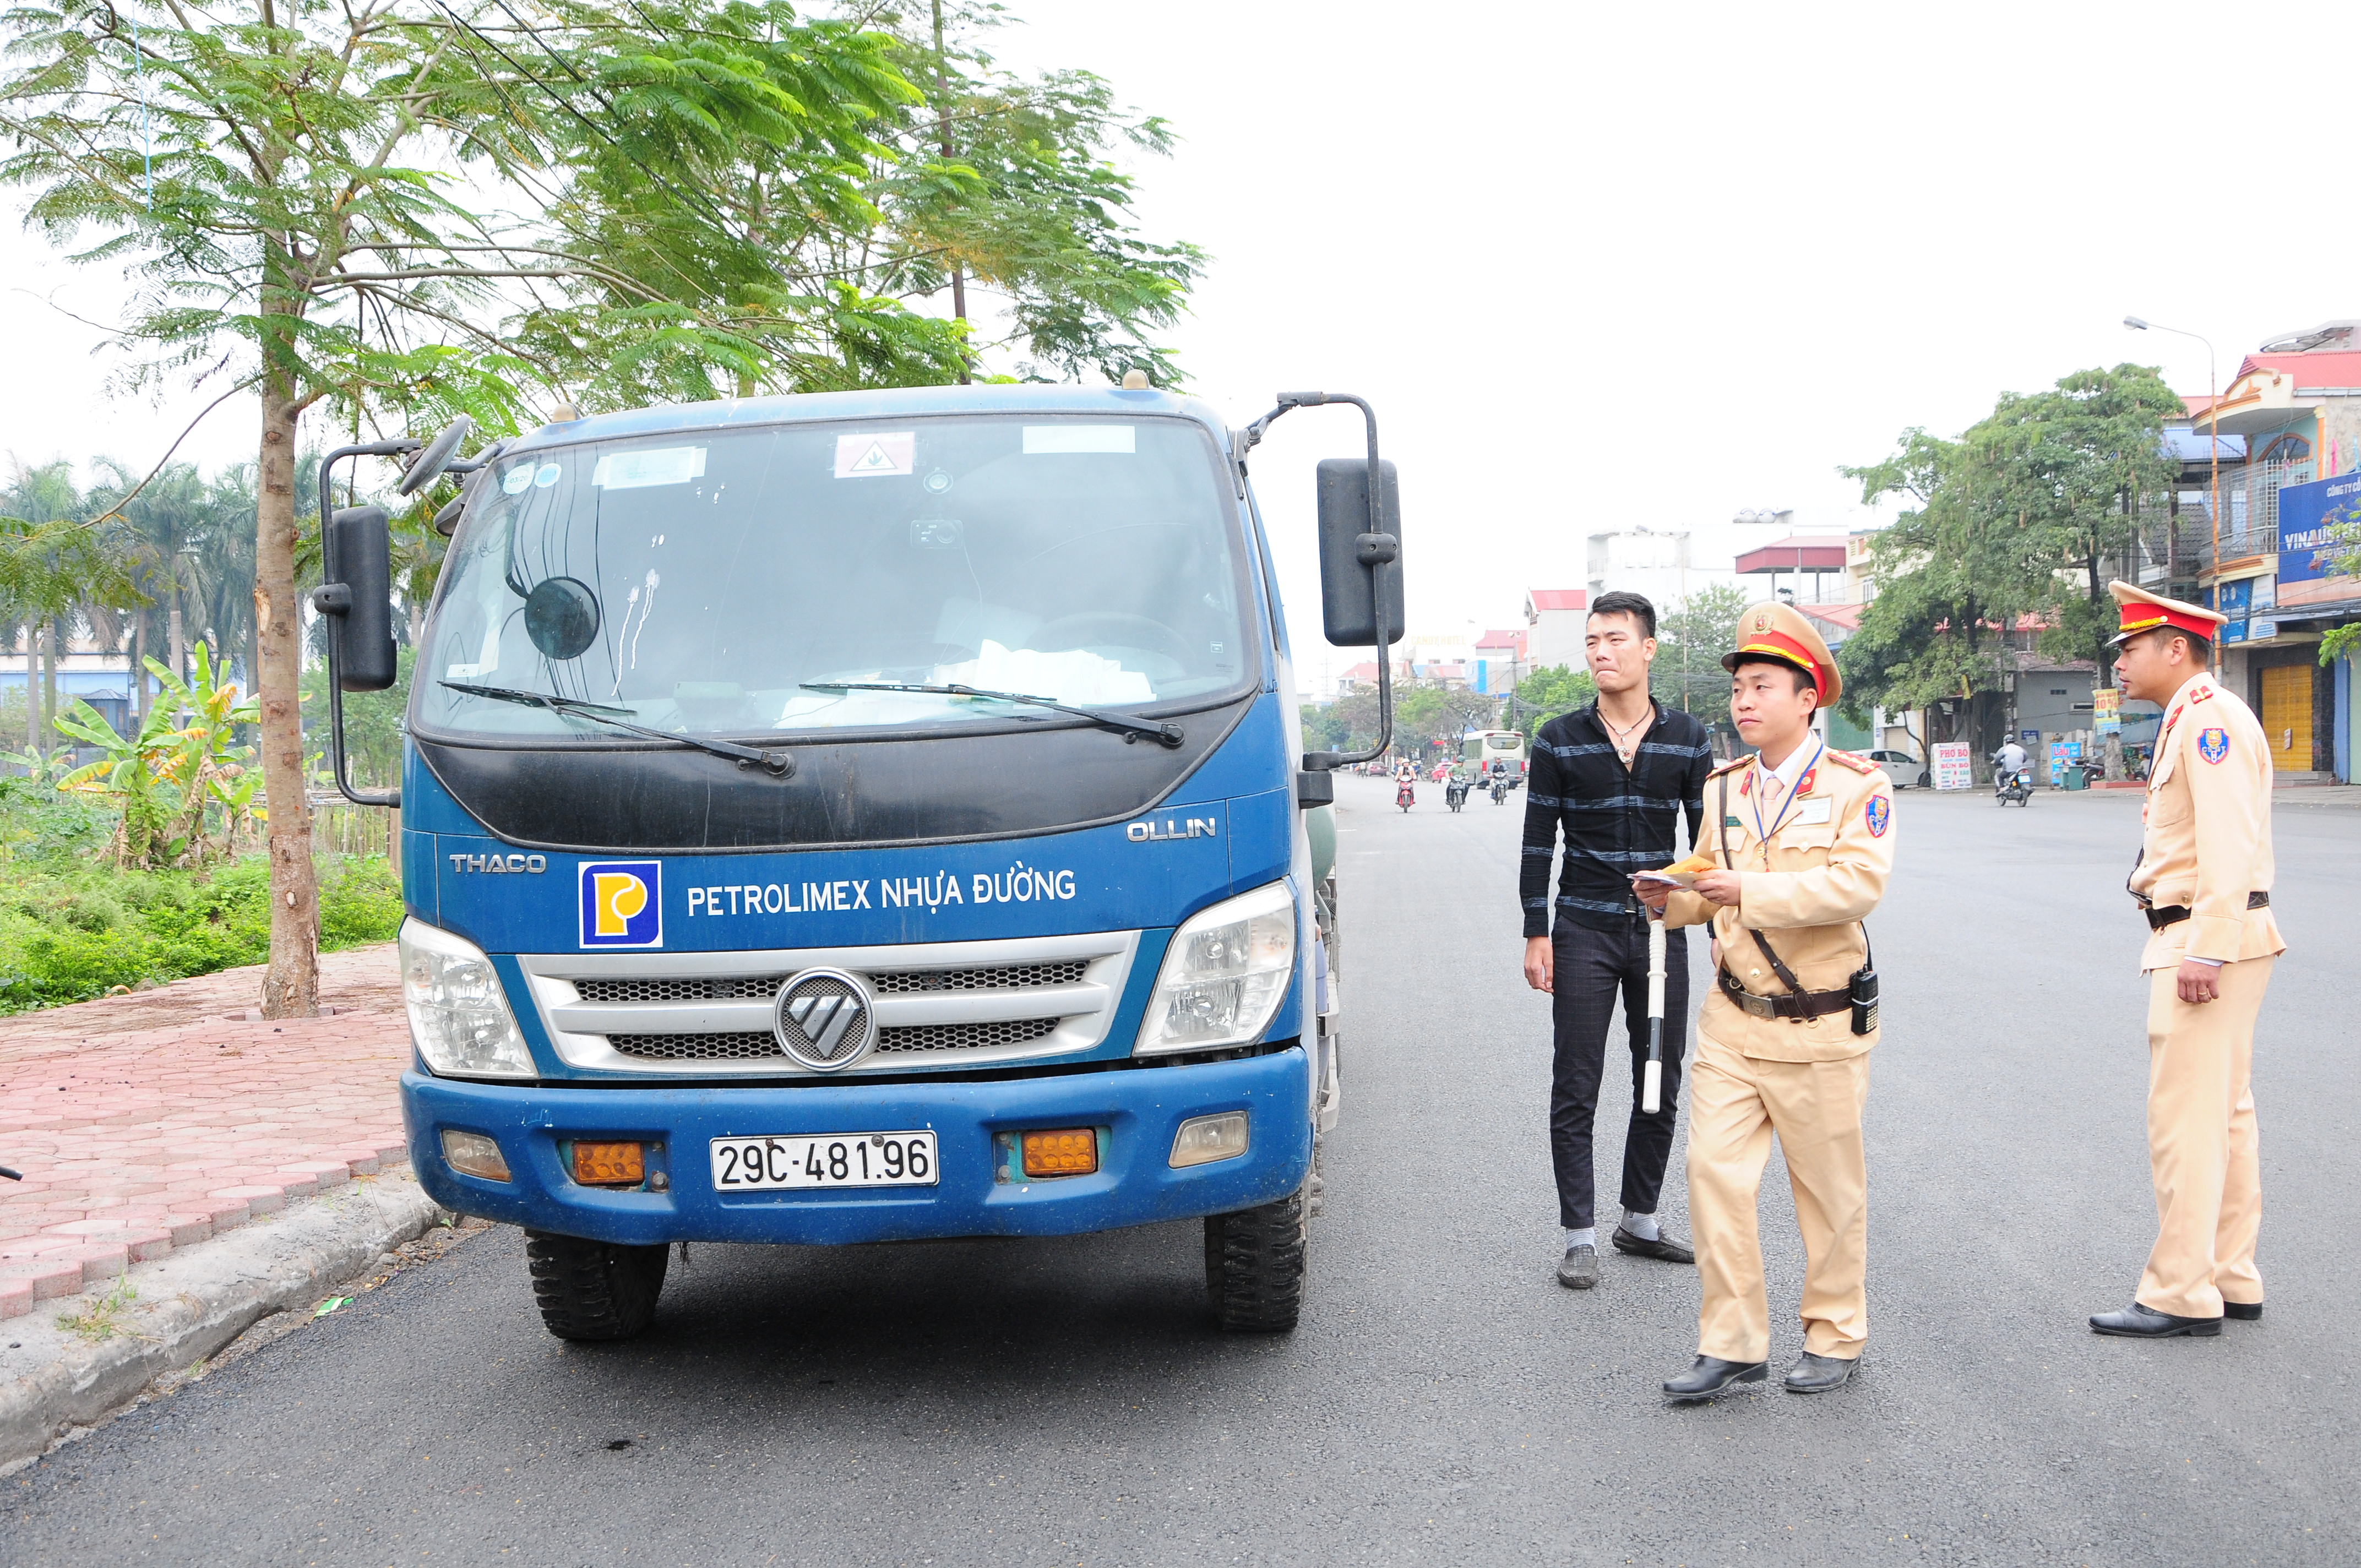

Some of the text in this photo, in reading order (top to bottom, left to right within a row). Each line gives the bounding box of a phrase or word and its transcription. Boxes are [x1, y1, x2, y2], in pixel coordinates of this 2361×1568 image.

[2344, 482, 2352, 494] TY
[1411, 636, 1466, 645] CANDY HOTEL
[2096, 699, 2117, 709] 10%
[1127, 818, 1216, 842] OLLIN
[449, 854, 546, 873] THACO
[687, 861, 1076, 917] PETROLIMEX NHỰA ĐƯỜNG
[719, 1139, 928, 1184] 29C-481.96
